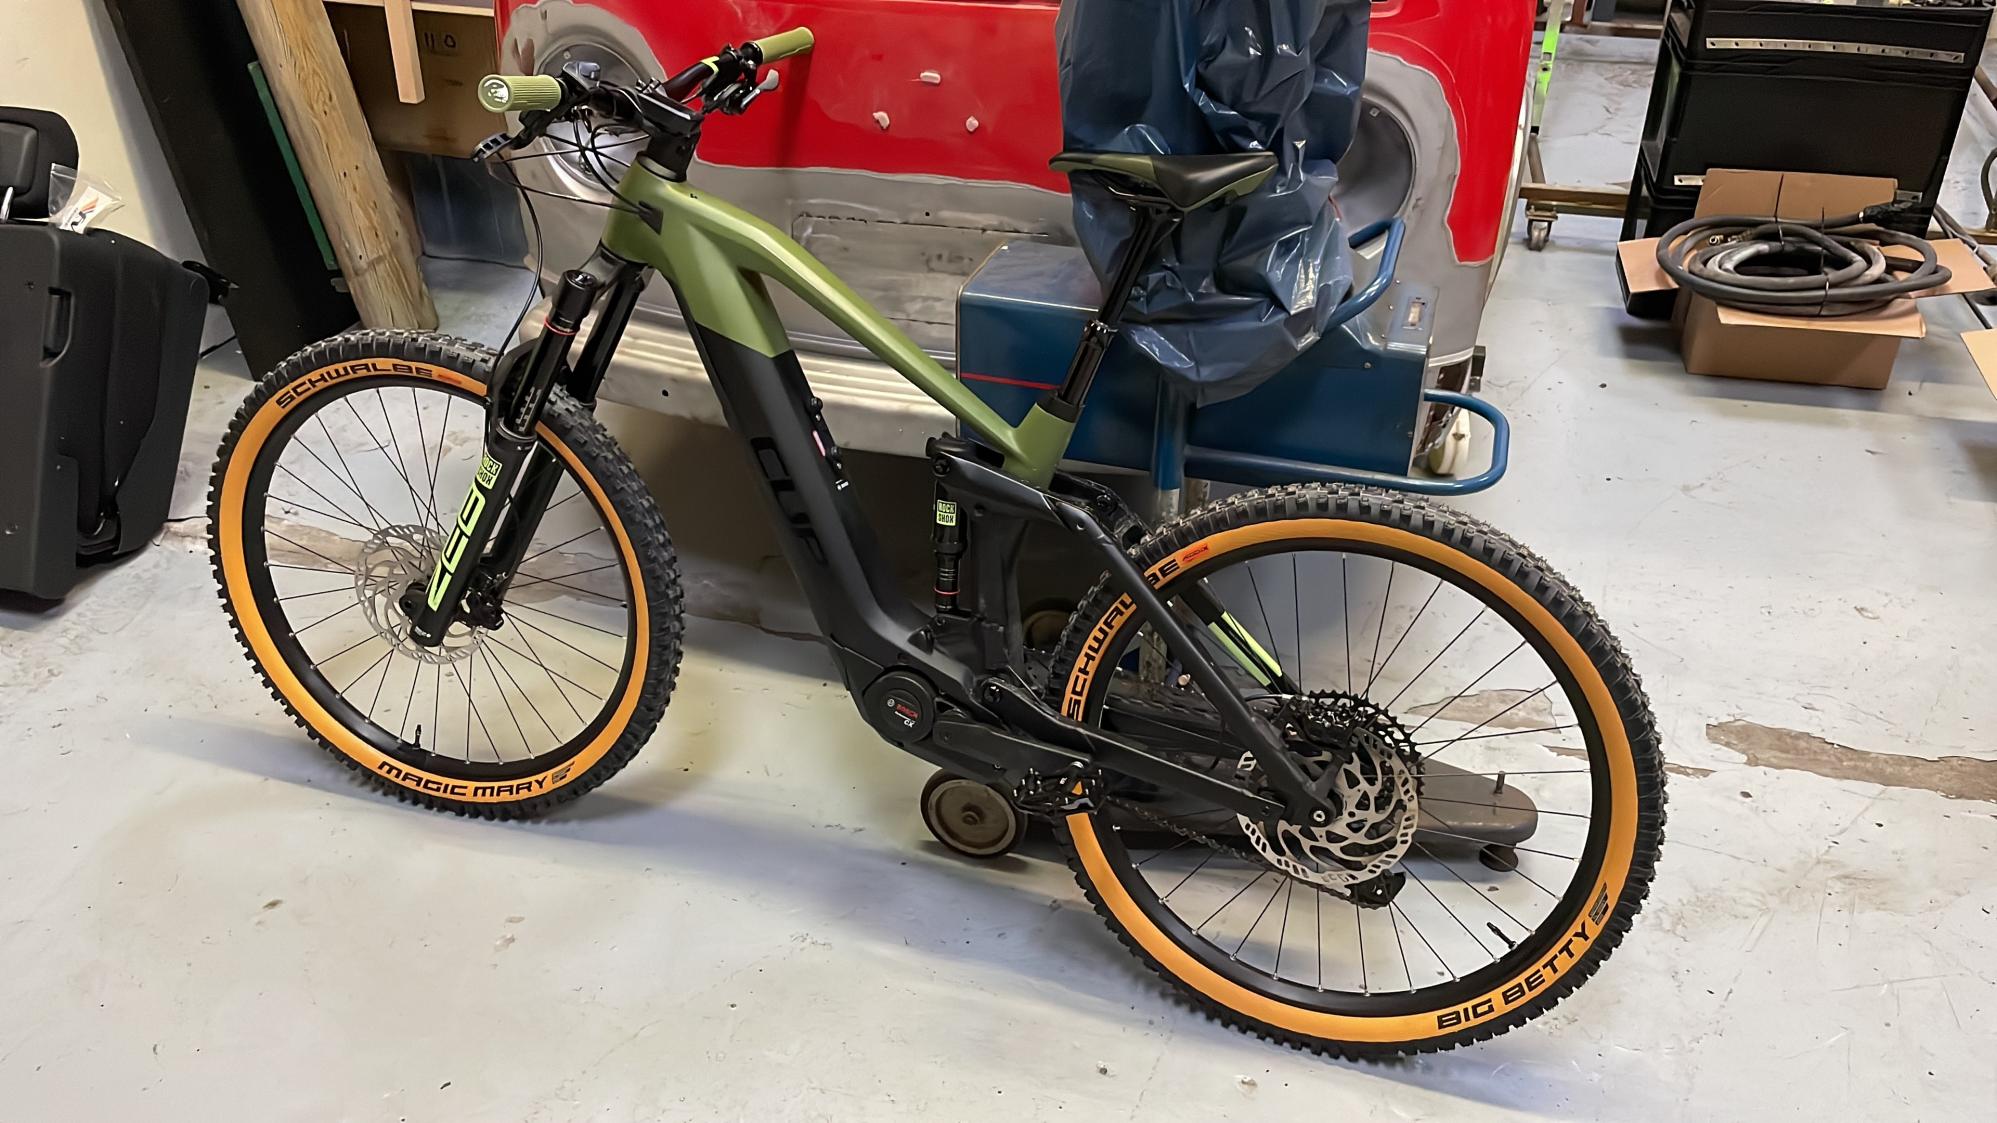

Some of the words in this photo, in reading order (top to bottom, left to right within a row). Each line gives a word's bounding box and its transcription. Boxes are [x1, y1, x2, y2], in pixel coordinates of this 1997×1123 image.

[275, 363, 433, 408] SCHWALBE
[378, 761, 469, 797] MAGIC
[473, 776, 548, 797] MARY
[1436, 998, 1495, 1030] BIG
[1501, 920, 1590, 1006] BETTY
